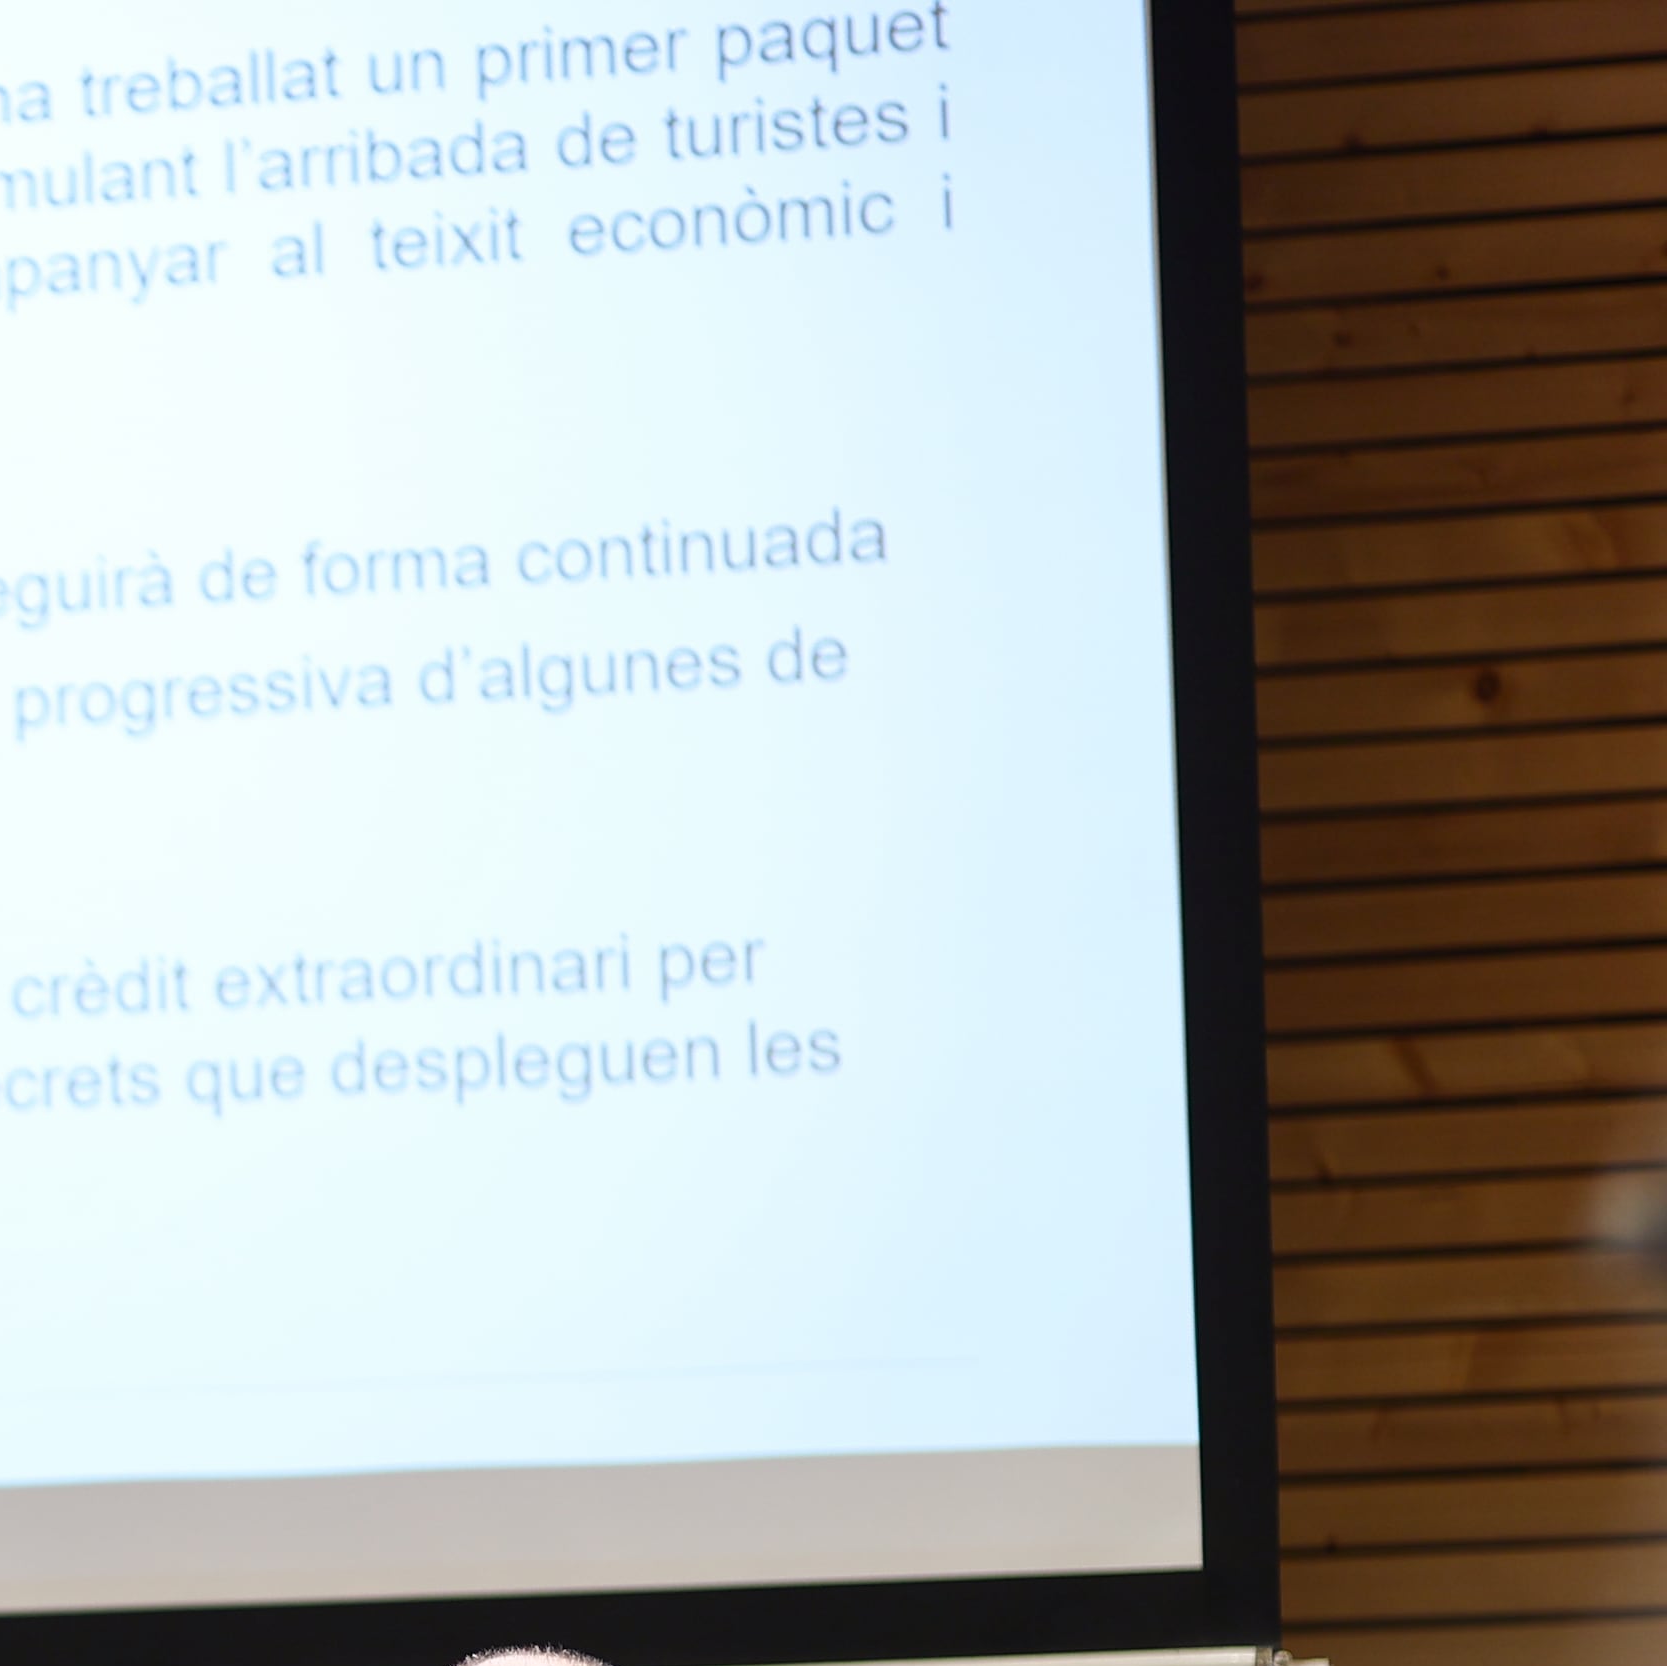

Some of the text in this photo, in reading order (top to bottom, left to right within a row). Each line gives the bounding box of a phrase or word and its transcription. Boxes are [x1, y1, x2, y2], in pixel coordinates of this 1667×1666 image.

[80, 50, 339, 117] treballat
[369, 49, 445, 95] un
[476, 30, 685, 100] primer
[717, 0, 948, 82] paquet
[557, 113, 636, 168] de
[664, 98, 909, 160] turistes
[938, 83, 951, 140] i
[272, 223, 324, 278] al
[371, 212, 522, 271] teixit
[568, 187, 894, 256] econòmic
[941, 173, 955, 230] i
[199, 549, 276, 603] de
[302, 541, 490, 595] forma
[517, 507, 887, 584] continuada
[15, 665, 392, 742] progressiva
[766, 627, 848, 684] de
[11, 959, 188, 1018] crèdit
[214, 941, 630, 1008] extraordinari
[659, 939, 763, 1003] per
[186, 1057, 305, 1117] que
[330, 1033, 720, 1105] despleguen
[748, 1021, 842, 1076] les
